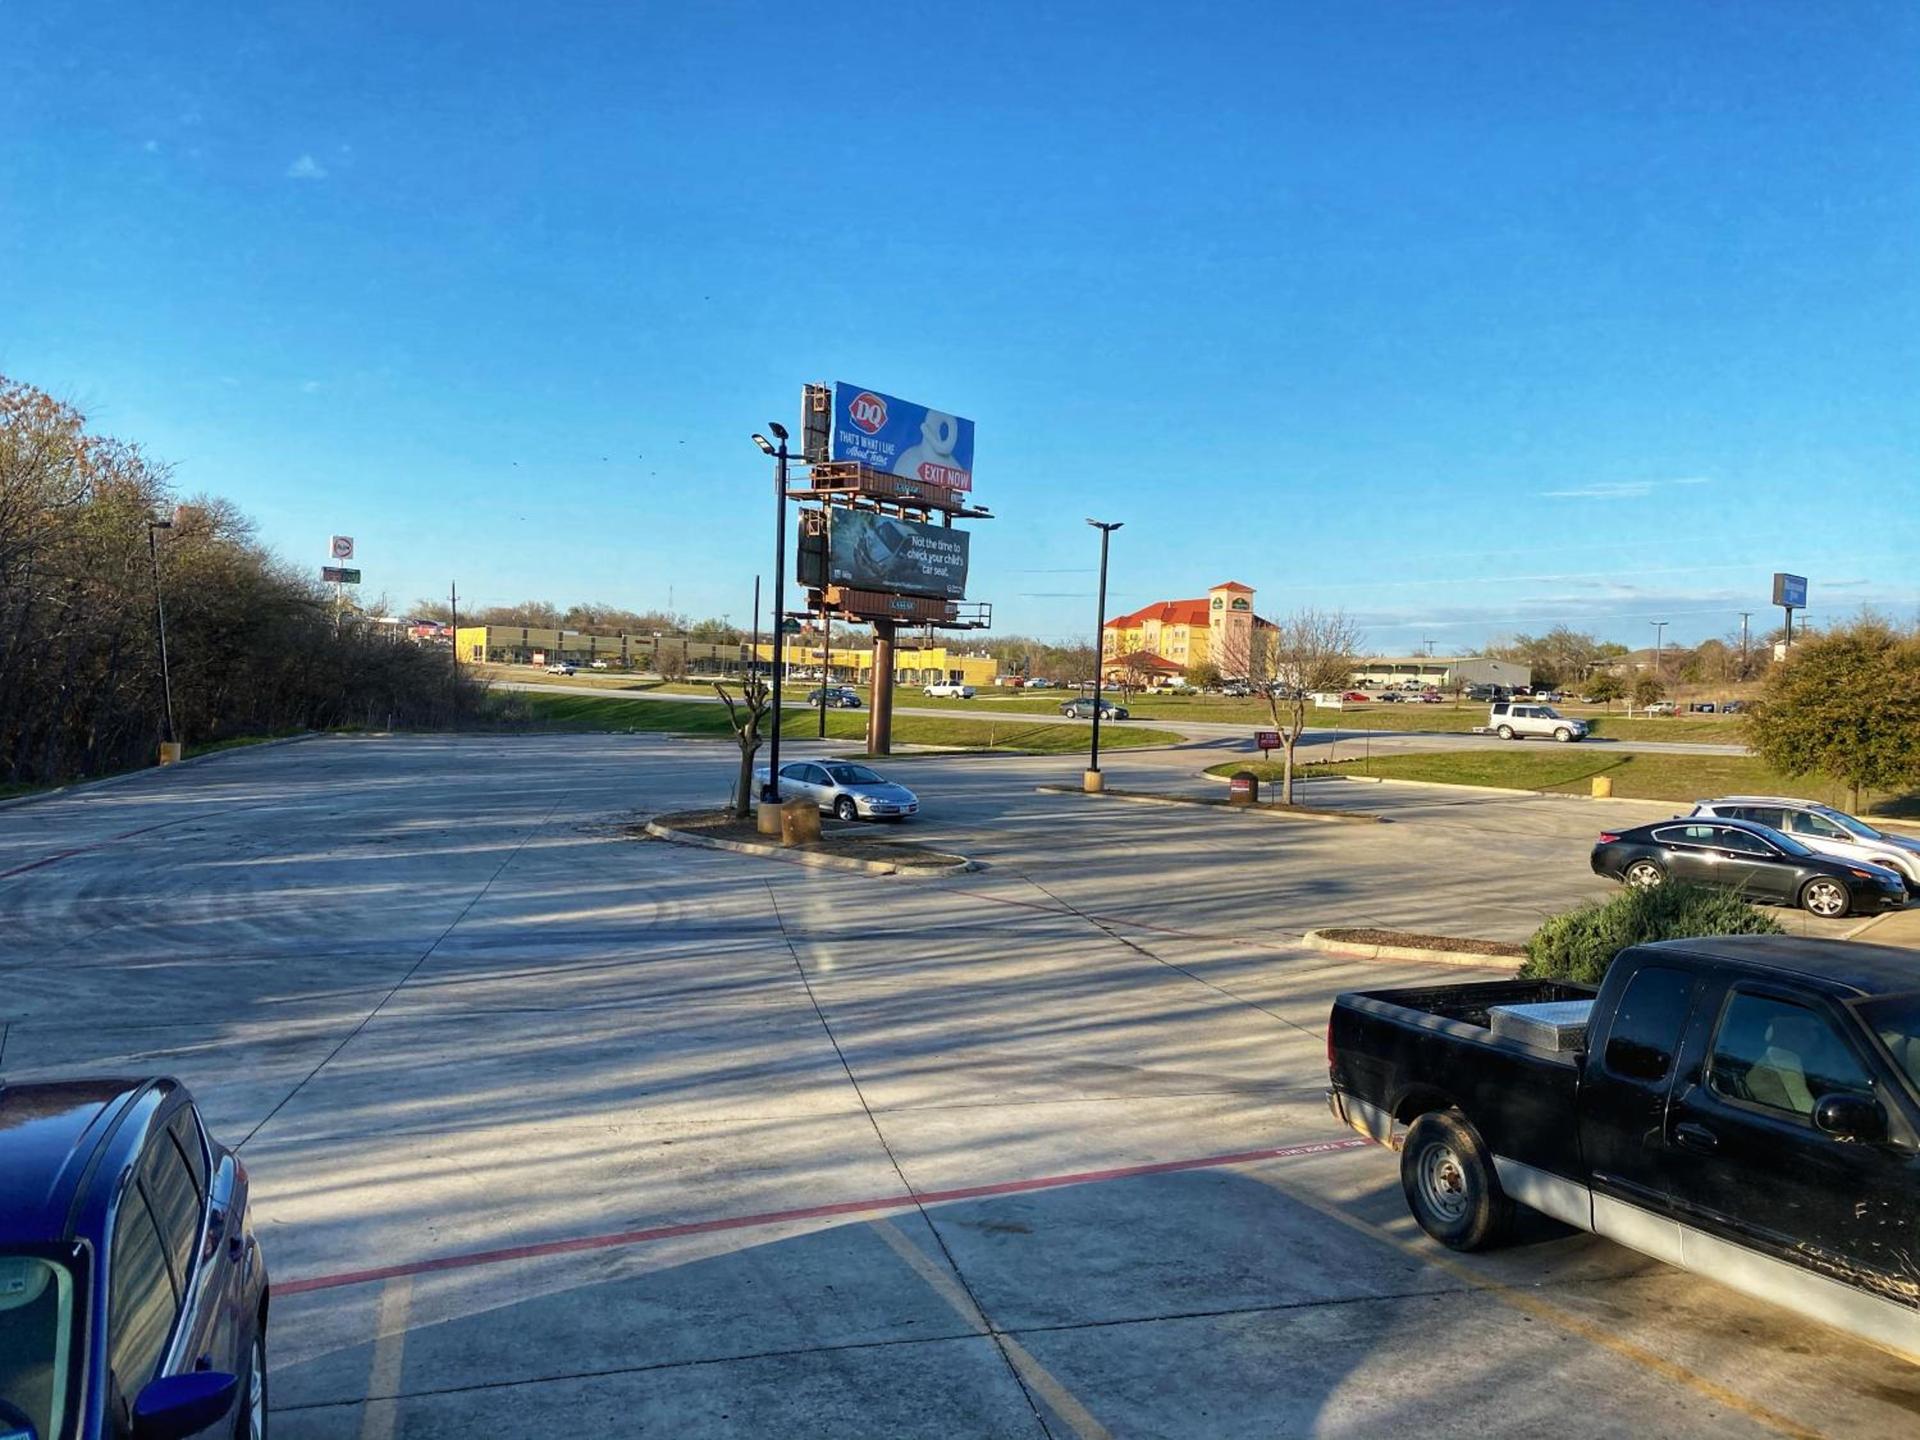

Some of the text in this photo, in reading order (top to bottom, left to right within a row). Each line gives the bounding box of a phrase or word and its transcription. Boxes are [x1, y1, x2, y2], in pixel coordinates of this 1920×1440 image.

[856, 400, 881, 428] DQ
[924, 464, 969, 489] EXIT NOW
[911, 536, 961, 553] Not the time to
[907, 548, 928, 561] check
[928, 554, 943, 564] your
[922, 566, 949, 577] car seat.
